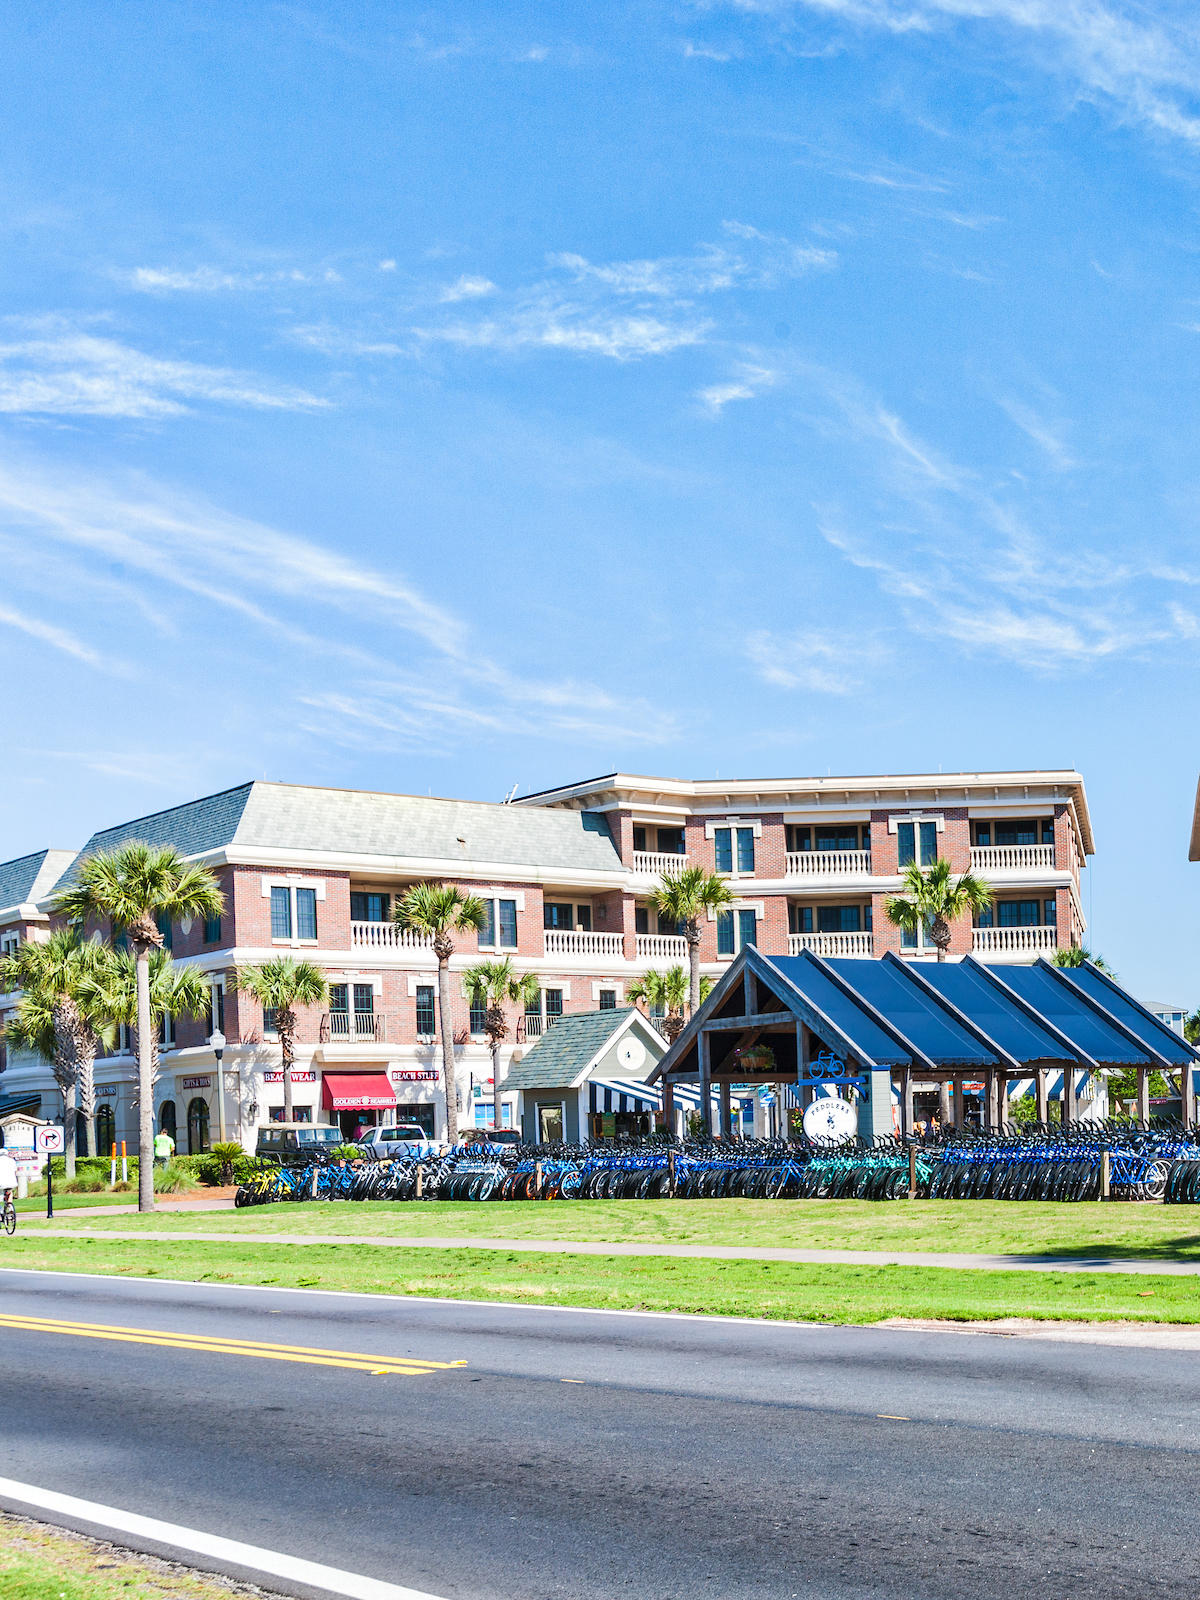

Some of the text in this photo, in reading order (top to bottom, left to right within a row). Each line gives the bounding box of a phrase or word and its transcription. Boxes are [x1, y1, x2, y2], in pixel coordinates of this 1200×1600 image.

[265, 1073, 316, 1081] BEAC WEAR
[392, 1071, 439, 1080] BEACH STUFF
[811, 1102, 850, 1116] PEDDLERS
